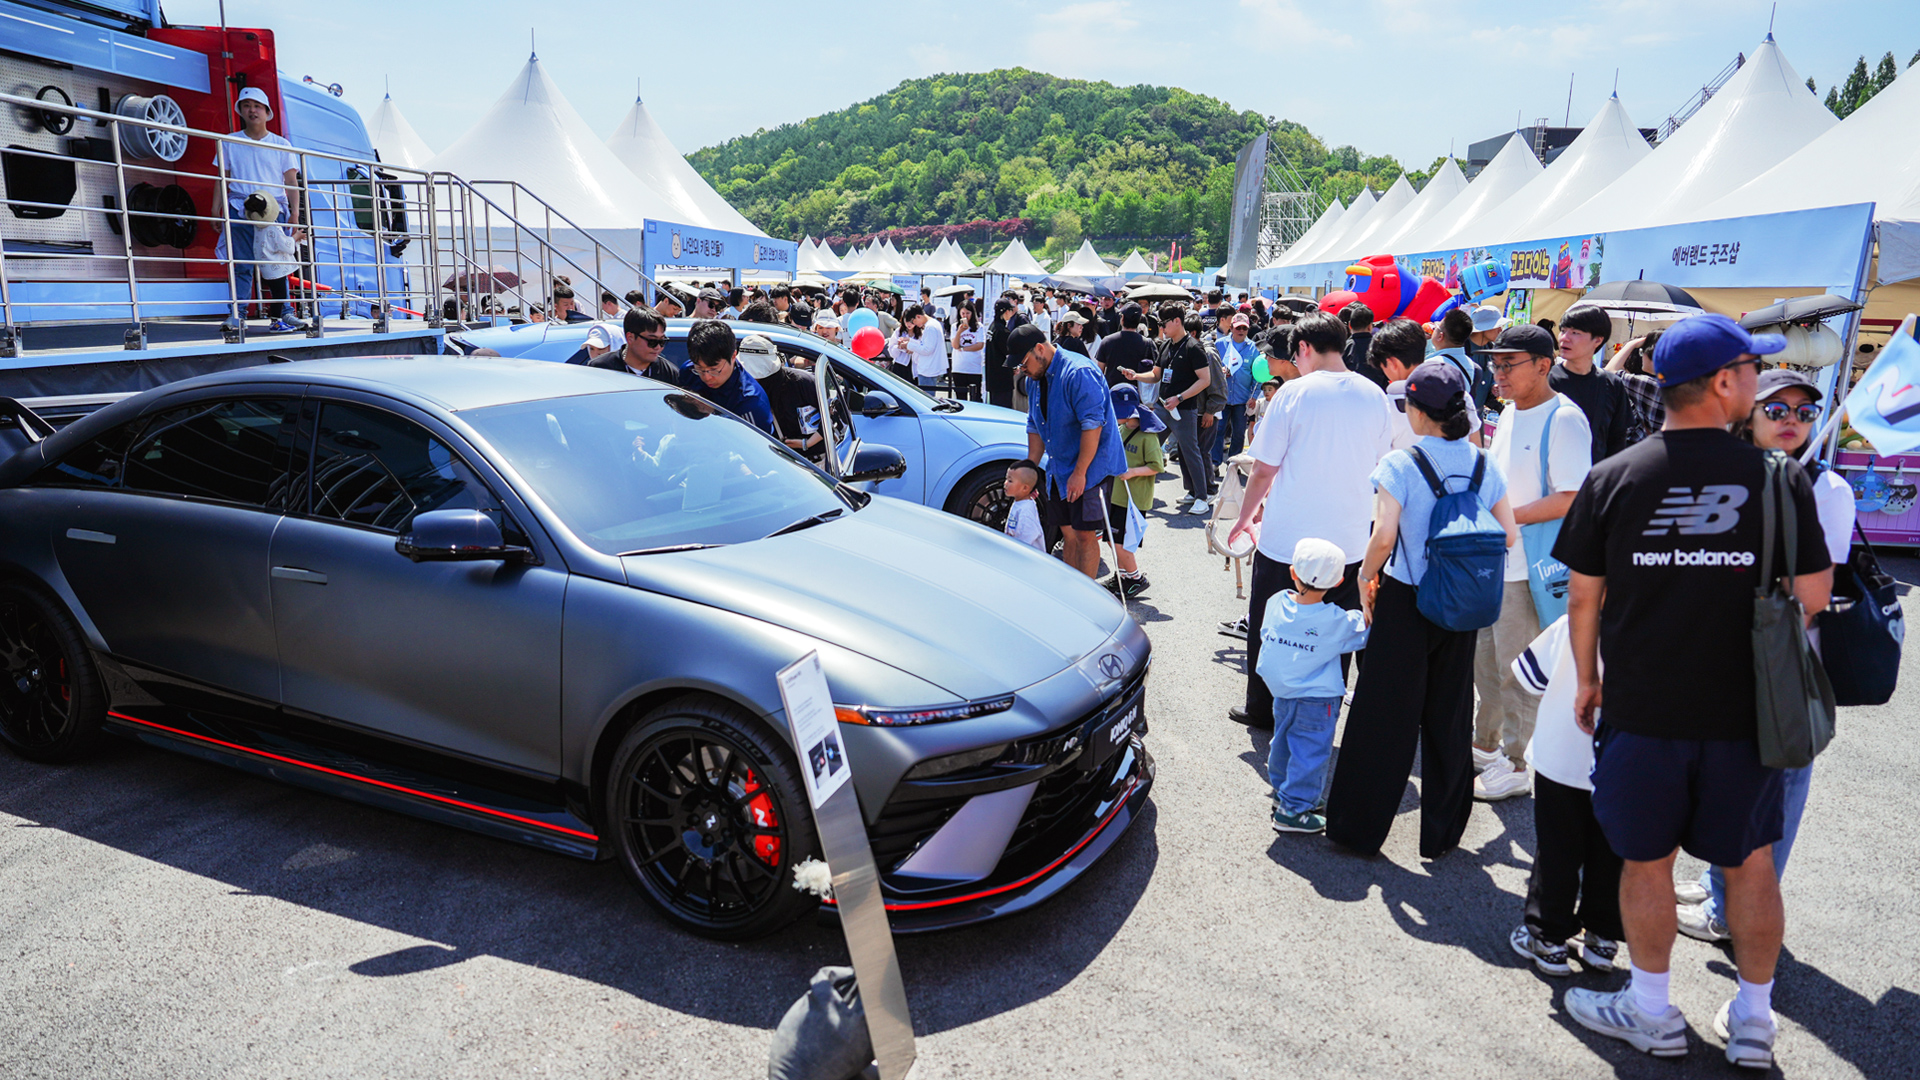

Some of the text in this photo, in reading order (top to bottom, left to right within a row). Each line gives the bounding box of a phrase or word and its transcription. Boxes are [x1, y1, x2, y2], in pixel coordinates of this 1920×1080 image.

[682, 236, 724, 257] 나만의 키링 만들기
[1672, 241, 1741, 266] 에버랜드 굿즈샵
[1510, 248, 1550, 281] 고고다이노
[1632, 548, 1755, 566] new balance
[1278, 637, 1315, 652] BALANCE
[722, 725, 763, 759] ZERO
